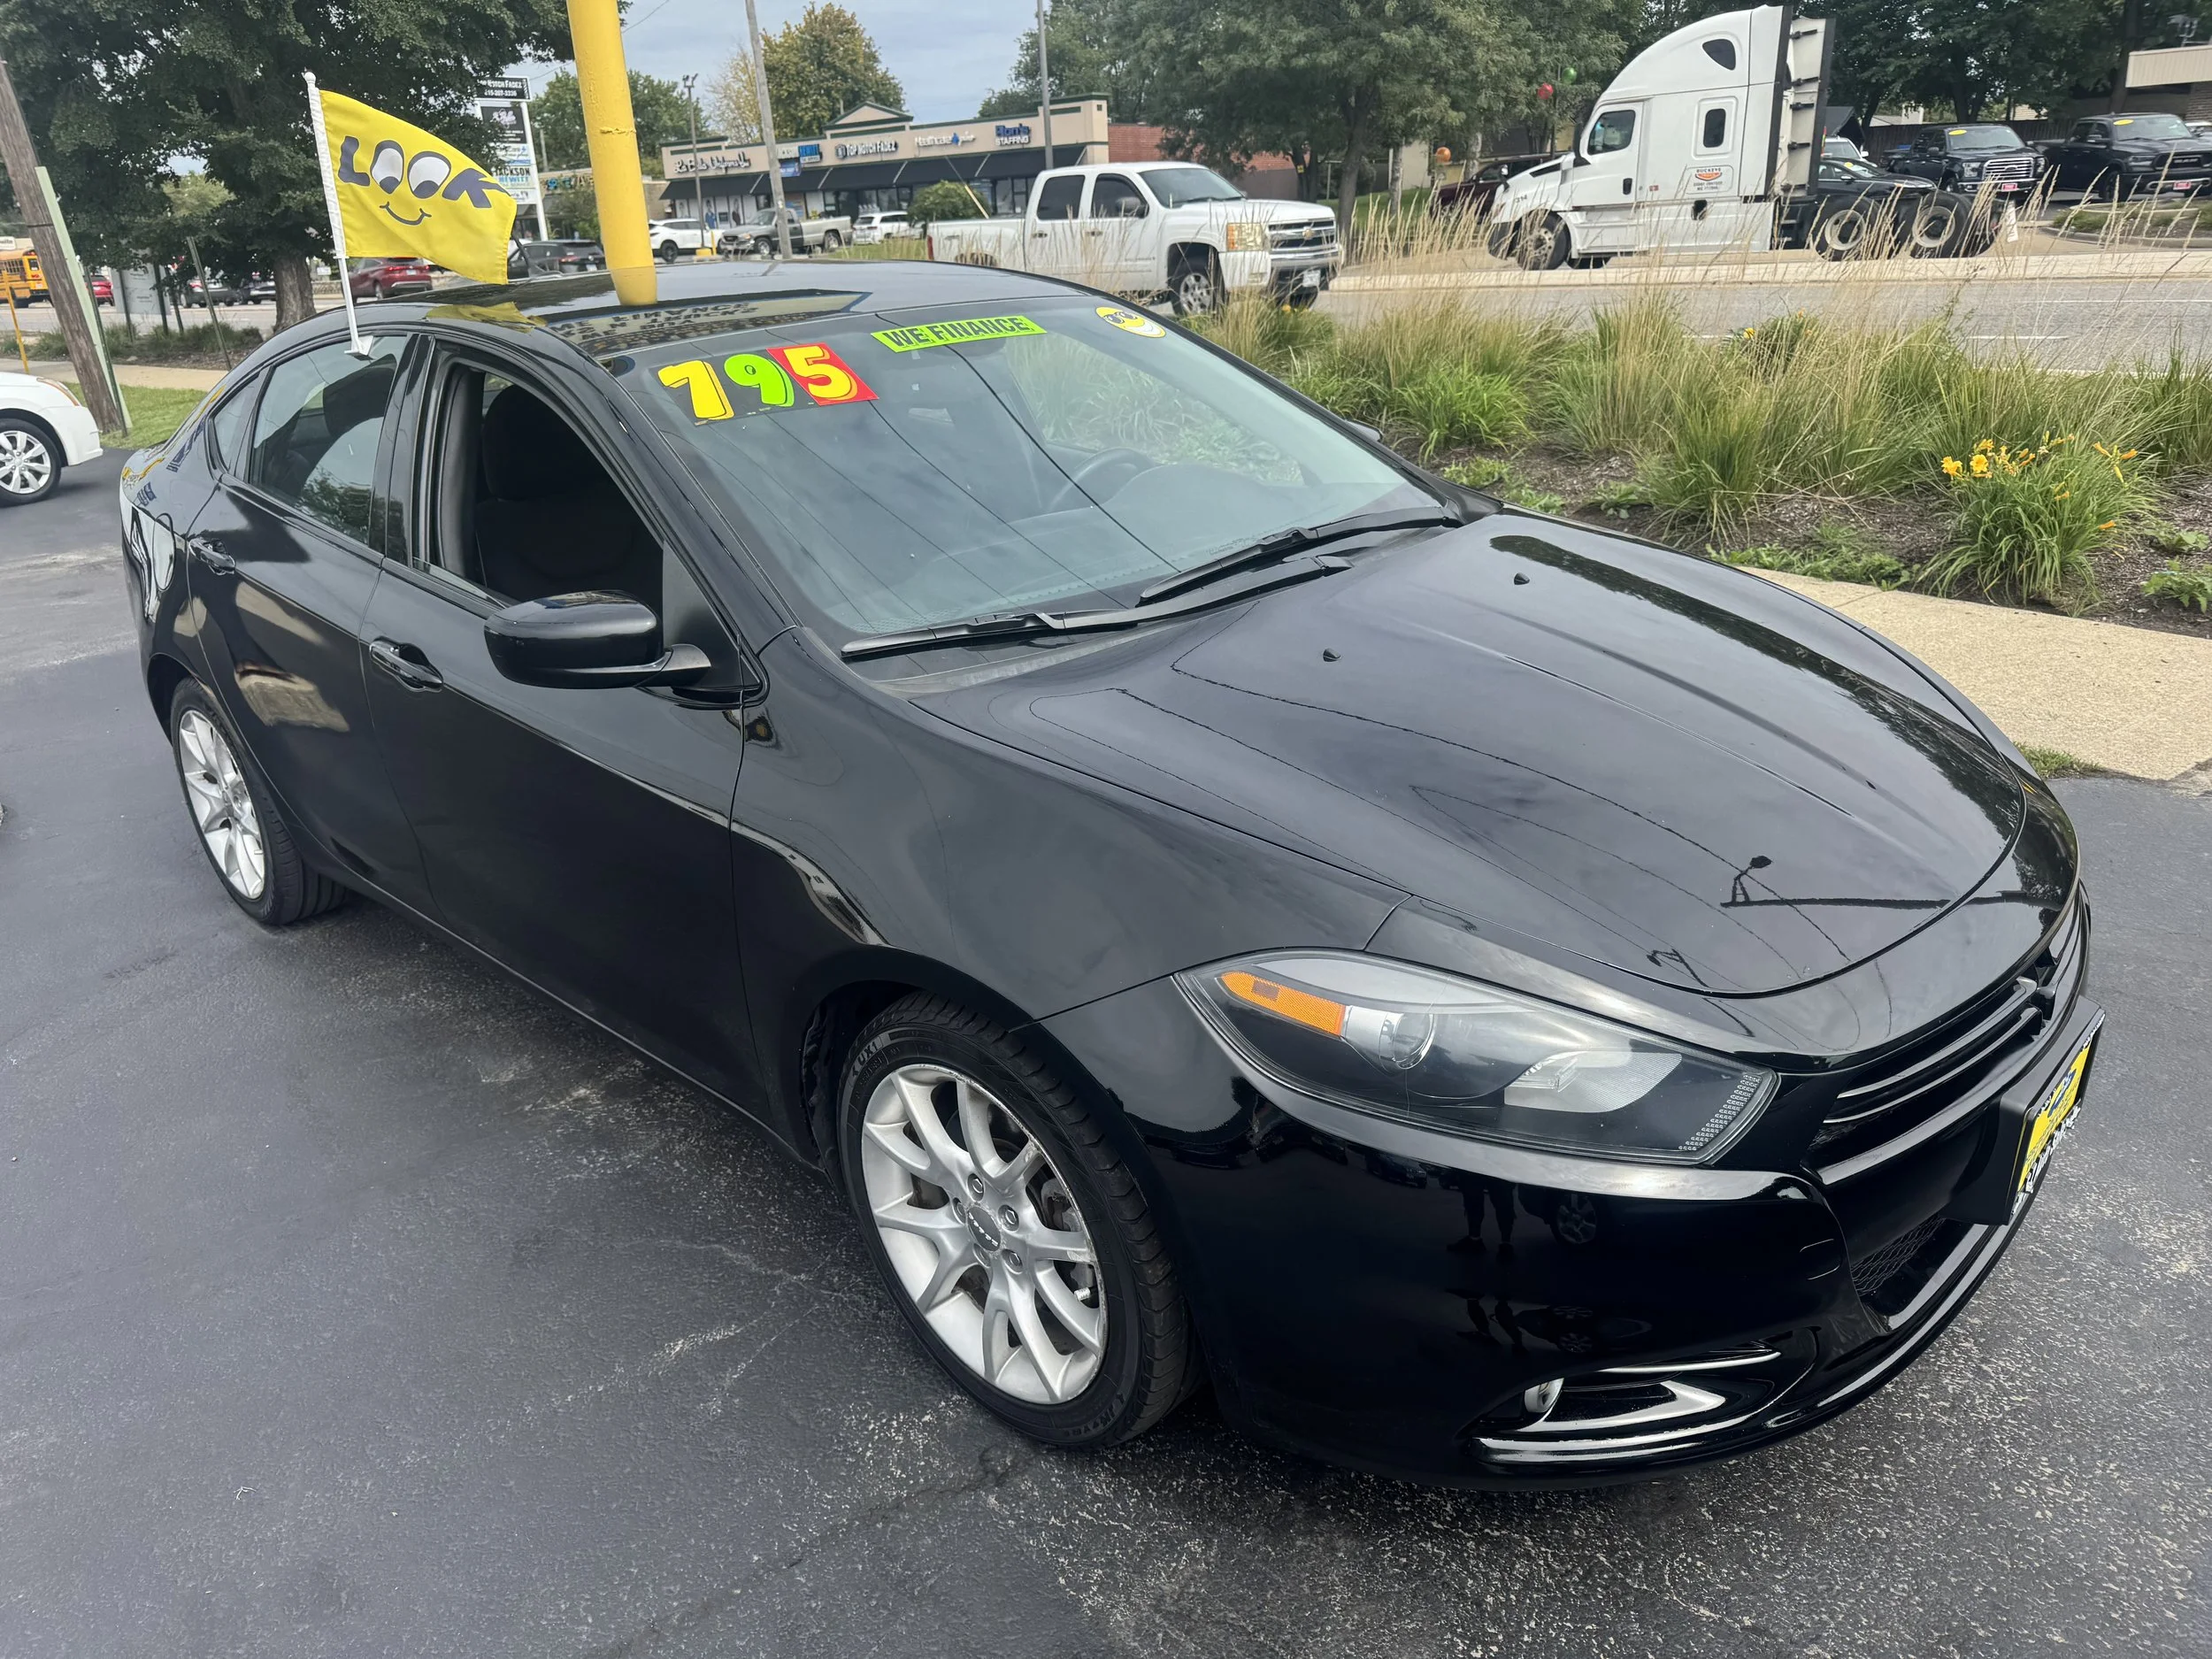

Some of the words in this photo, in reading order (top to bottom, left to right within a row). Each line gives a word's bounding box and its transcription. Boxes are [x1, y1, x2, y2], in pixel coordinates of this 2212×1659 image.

[338, 135, 511, 209] LOOK
[884, 327, 931, 347] WE
[926, 318, 1033, 342] FINANCE
[658, 346, 858, 420] 795
